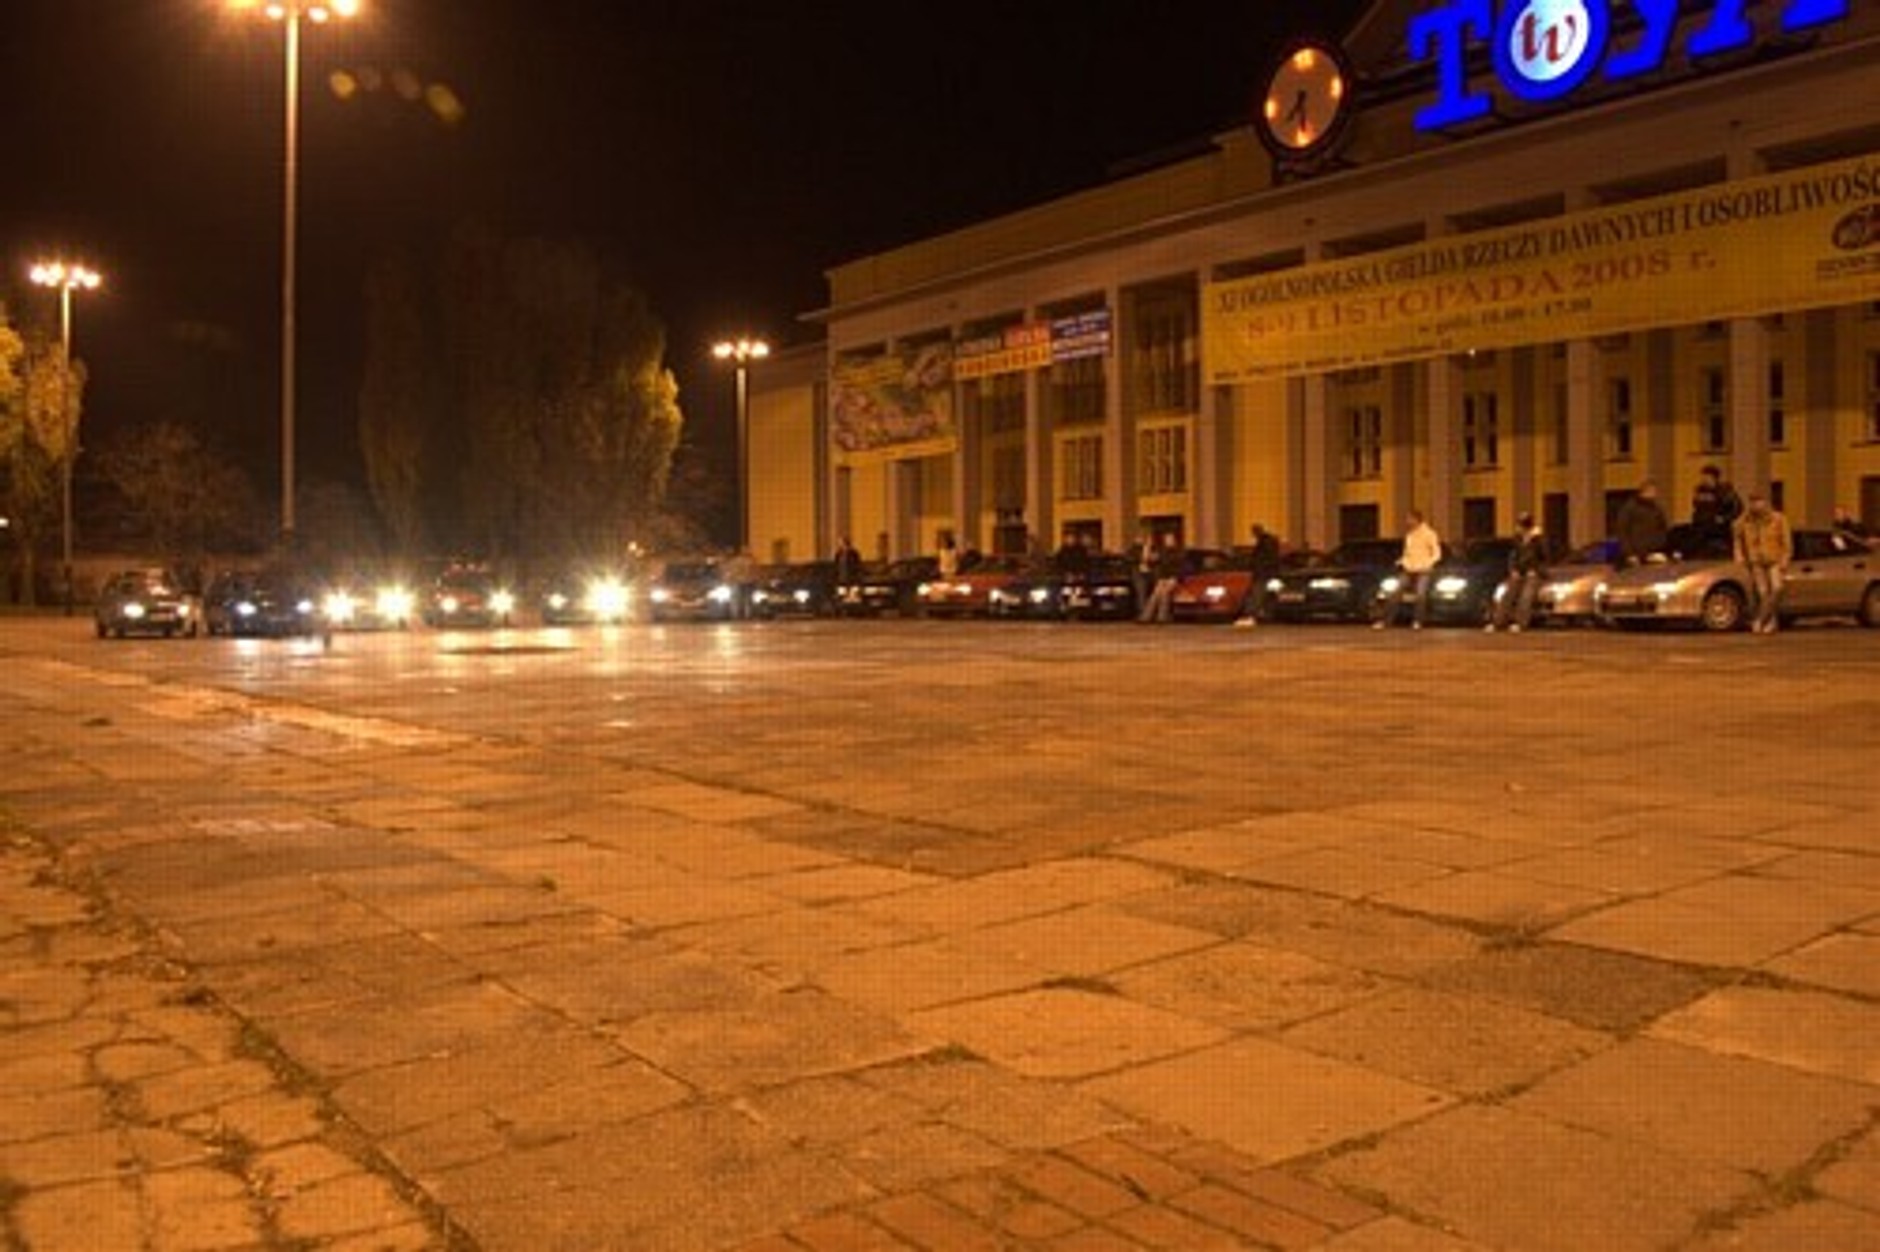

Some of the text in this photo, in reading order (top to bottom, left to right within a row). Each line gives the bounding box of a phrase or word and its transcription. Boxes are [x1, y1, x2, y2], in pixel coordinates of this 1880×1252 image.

[1551, 206, 1675, 255] DAWNYCH
[1307, 269, 1563, 331] LISTOPADA
[1571, 249, 1670, 289] 2008
[1691, 251, 1716, 271] r.
